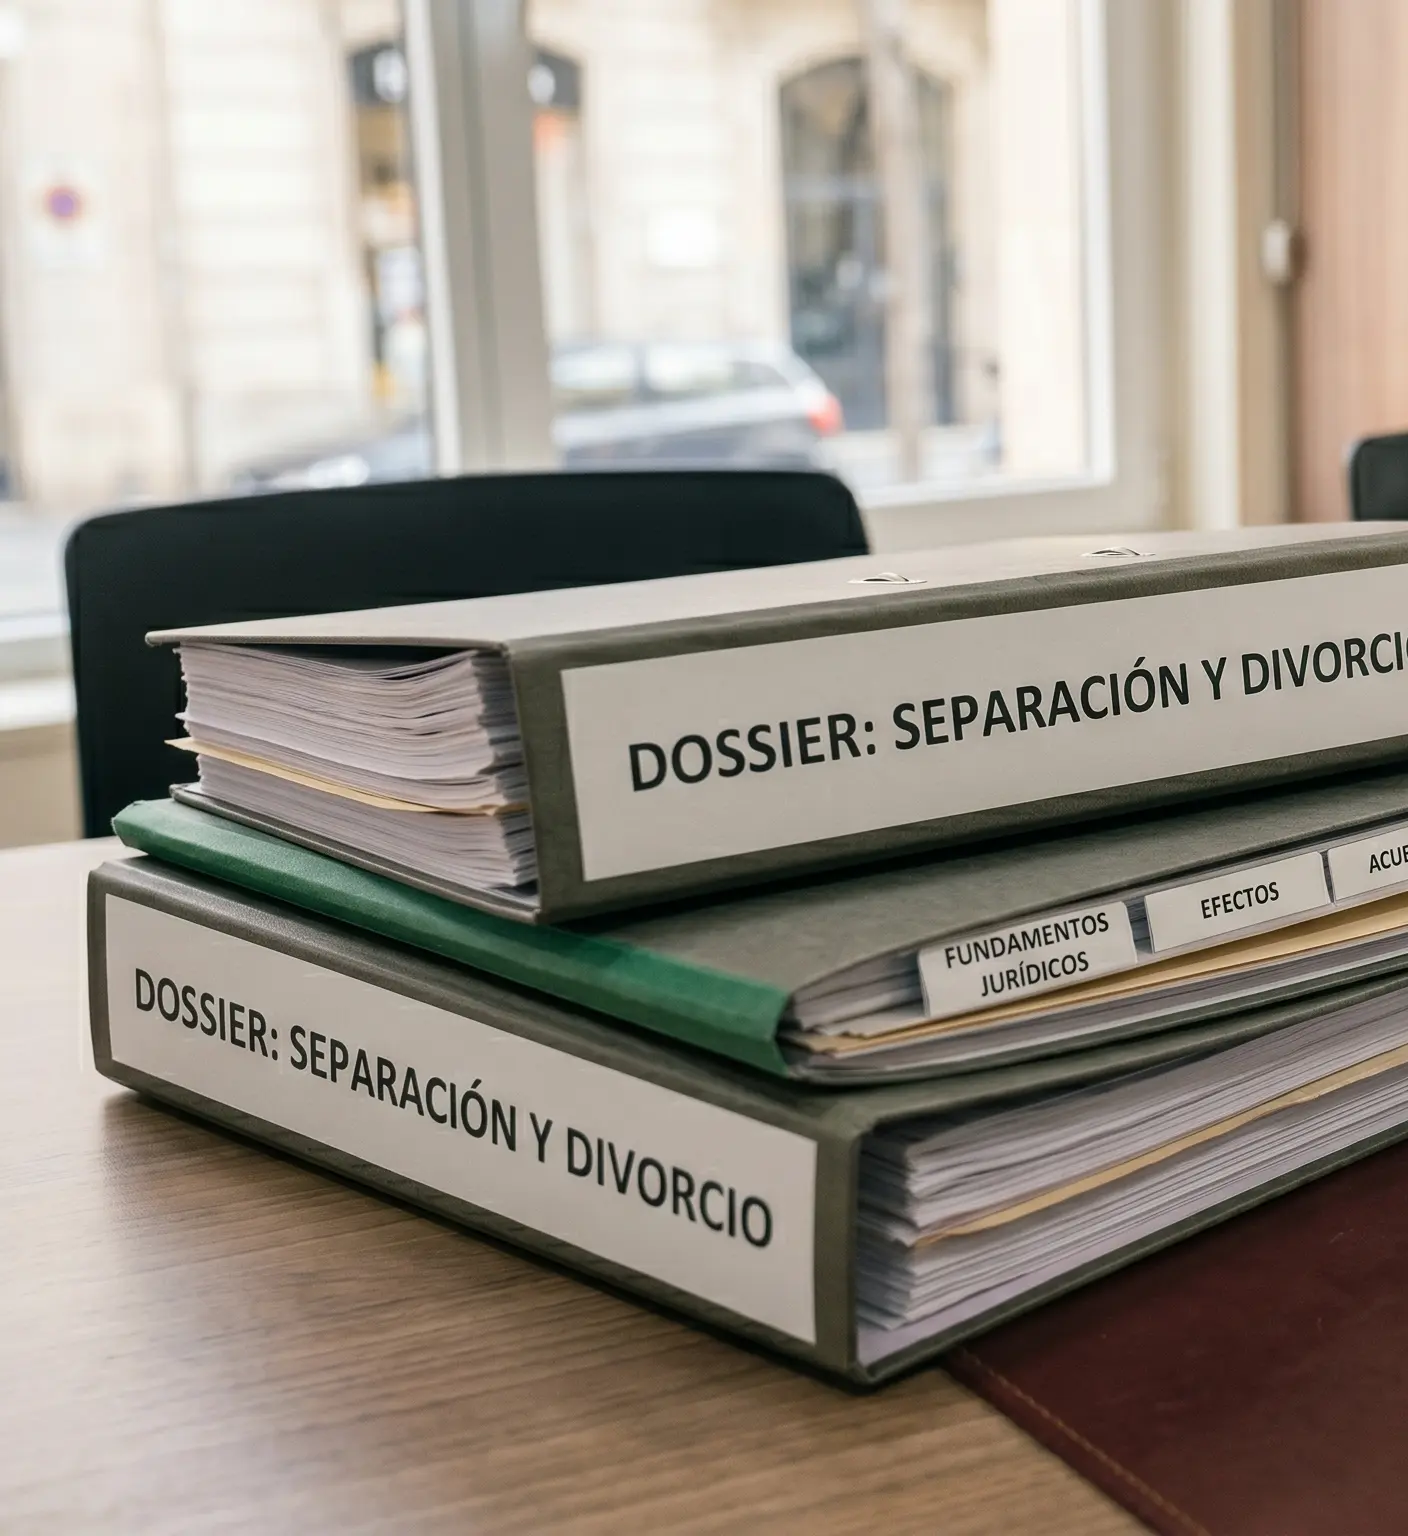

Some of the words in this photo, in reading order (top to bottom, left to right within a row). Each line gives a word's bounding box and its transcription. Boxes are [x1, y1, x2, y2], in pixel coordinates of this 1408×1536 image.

[628, 713, 877, 792] DOSSIER:
[892, 656, 1191, 750] SEPARACIÓN
[1200, 656, 1228, 701] Y
[1200, 881, 1280, 919] EFECTOS
[944, 912, 1110, 969] FUNDAMENTOS
[981, 951, 1089, 997] JURÍDICOS
[135, 967, 279, 1061] DOSSIER:
[290, 1025, 517, 1152] SEPARACIÓN
[529, 1112, 553, 1163] Y
[567, 1127, 772, 1248] DIVORCIO
